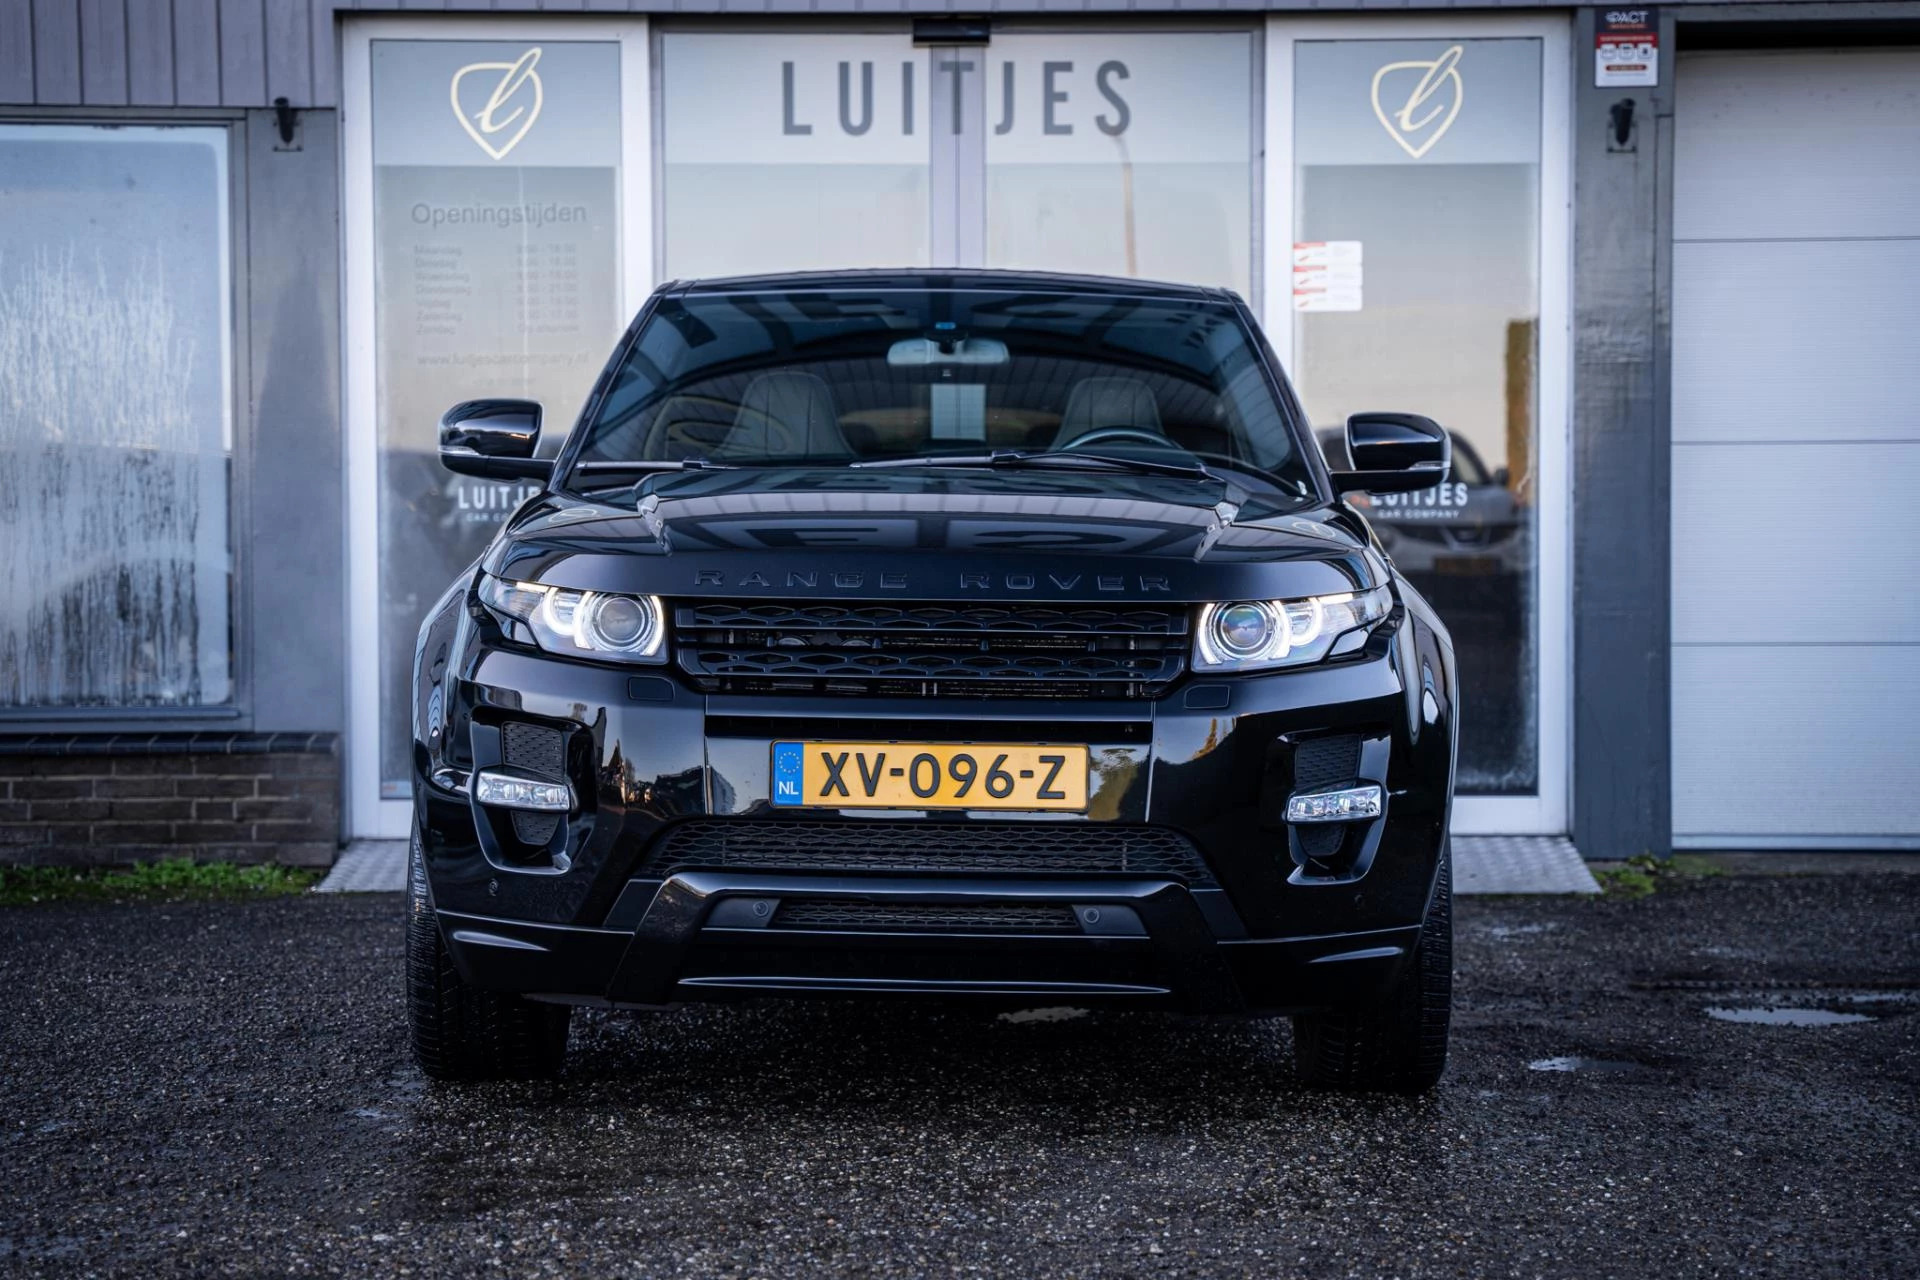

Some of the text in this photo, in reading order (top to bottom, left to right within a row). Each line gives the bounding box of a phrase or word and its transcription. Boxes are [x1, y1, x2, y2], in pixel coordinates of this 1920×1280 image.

[782, 60, 1131, 136] LUITJES
[411, 202, 587, 229] Openingstijden
[694, 570, 1171, 591] RANGE ROVER
[778, 752, 1066, 799] NL XV-096-Z
